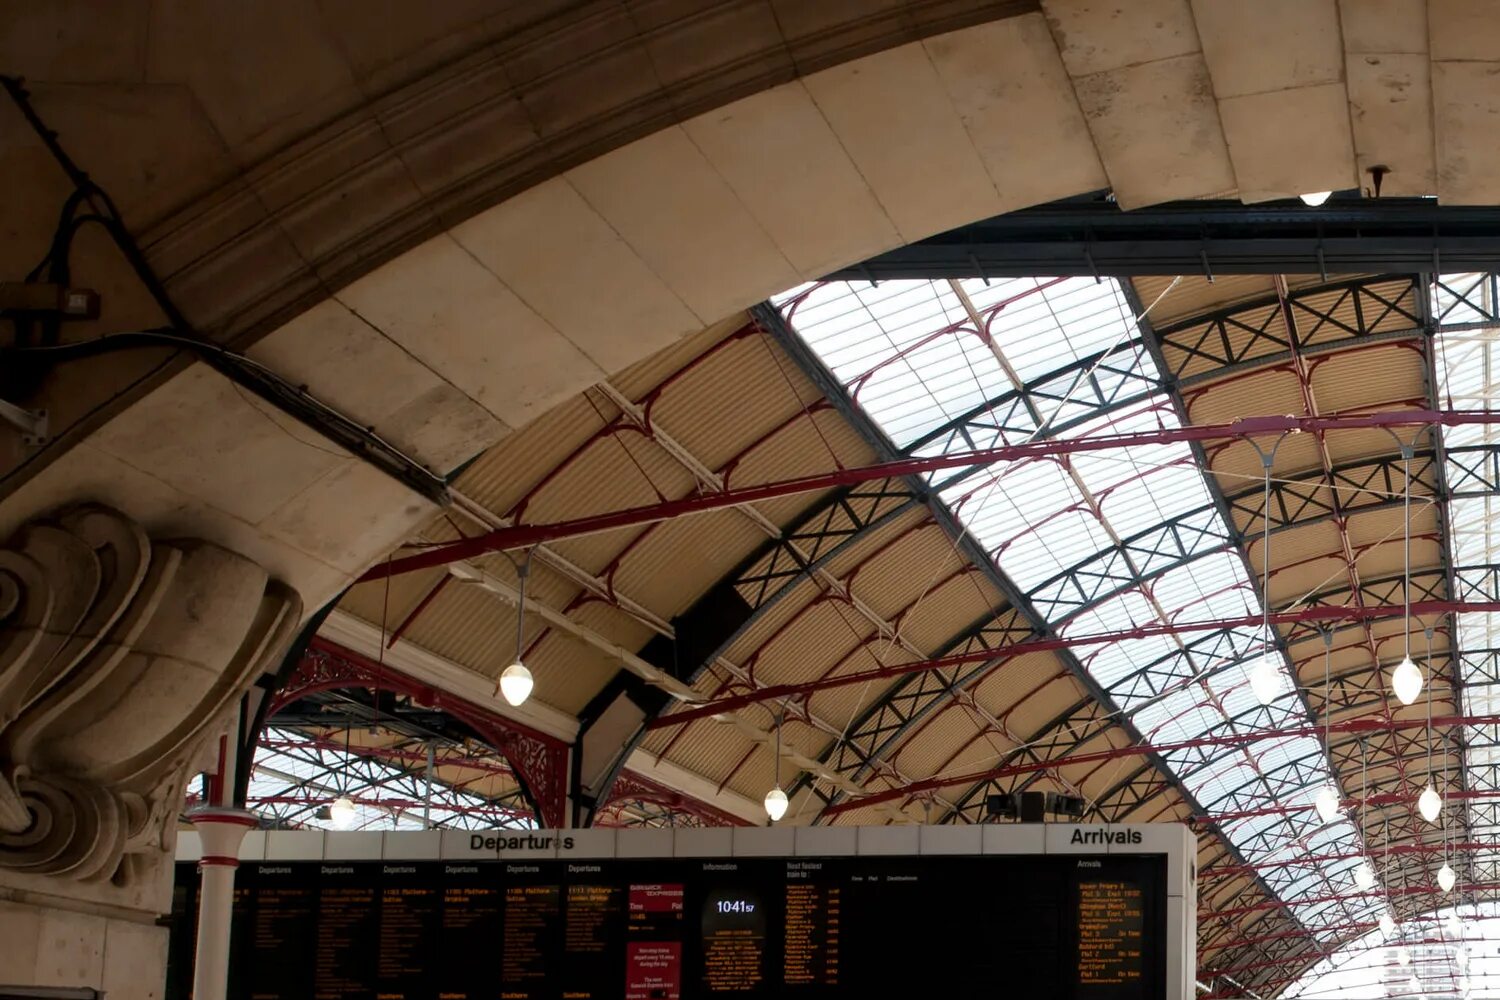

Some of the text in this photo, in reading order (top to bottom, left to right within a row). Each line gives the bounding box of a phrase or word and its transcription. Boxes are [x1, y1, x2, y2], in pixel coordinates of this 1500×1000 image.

[1071, 829, 1142, 844] Arrivals
[568, 864, 601, 873] Departures
[702, 863, 738, 871] Information
[1077, 860, 1102, 868] Arrivals
[445, 865, 478, 875] Departures
[507, 865, 540, 874] Departures
